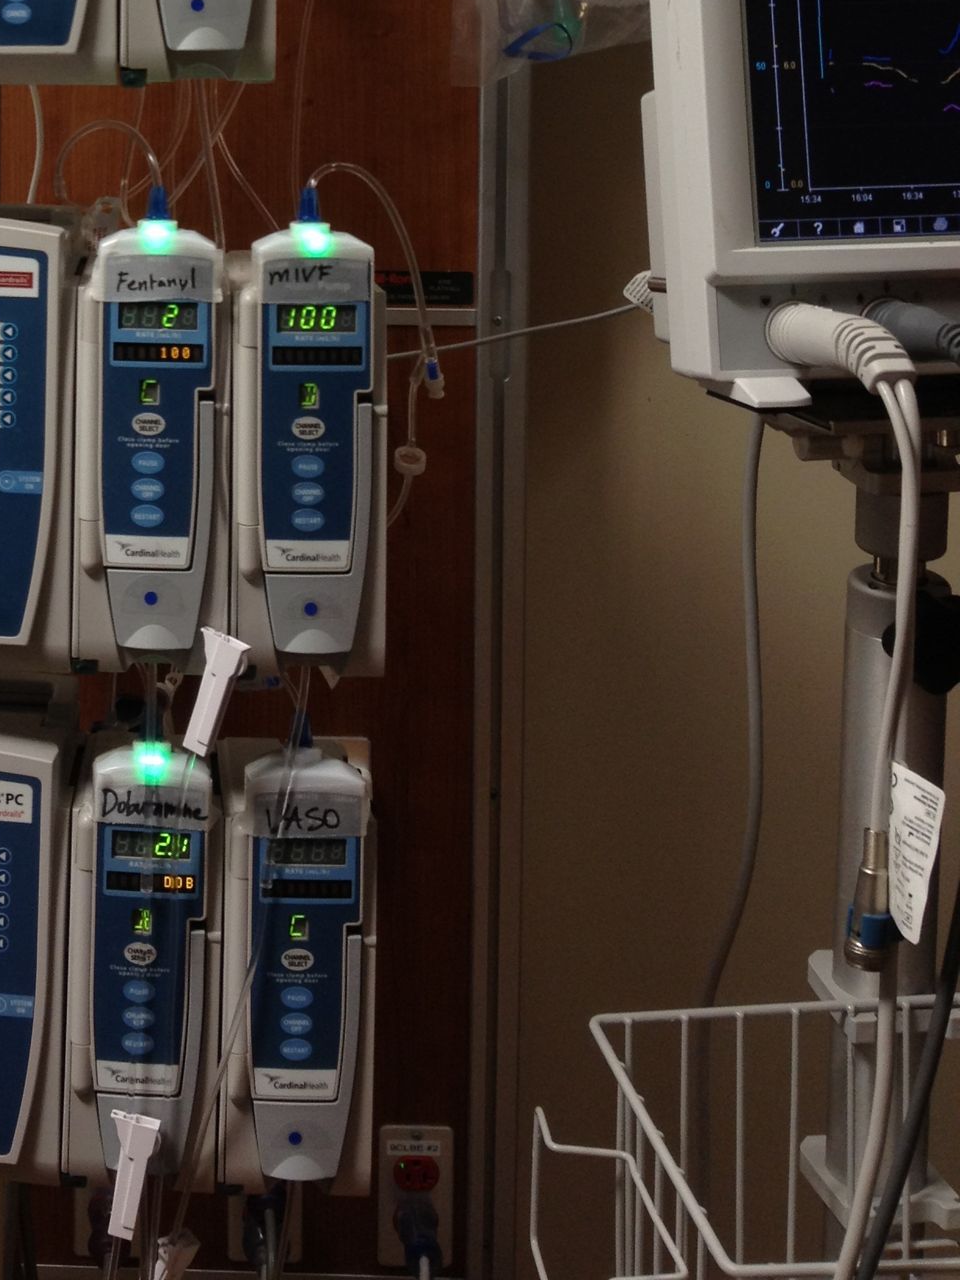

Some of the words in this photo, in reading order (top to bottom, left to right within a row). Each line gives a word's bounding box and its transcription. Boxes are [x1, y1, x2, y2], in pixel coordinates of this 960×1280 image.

[756, 62, 766, 70] 50
[784, 61, 796, 69] 6.0
[765, 181, 771, 190] 0
[790, 179, 803, 188] 0.0
[800, 195, 822, 204] 15:34
[851, 193, 873, 202] 16:04
[902, 192, 924, 200] 16:34
[116, 267, 196, 292] Fentanyl
[162, 304, 178, 328] 2
[289, 306, 336, 330] 100
[160, 347, 190, 360] 100
[141, 379, 157, 402] C
[125, 549, 180, 558] CardinalHealth
[286, 553, 341, 562] CardinalHealth
[6, 793, 24, 806] PC
[266, 806, 340, 833] VASO
[290, 914, 305, 936] C
[274, 1082, 329, 1090] CardinalHealth
